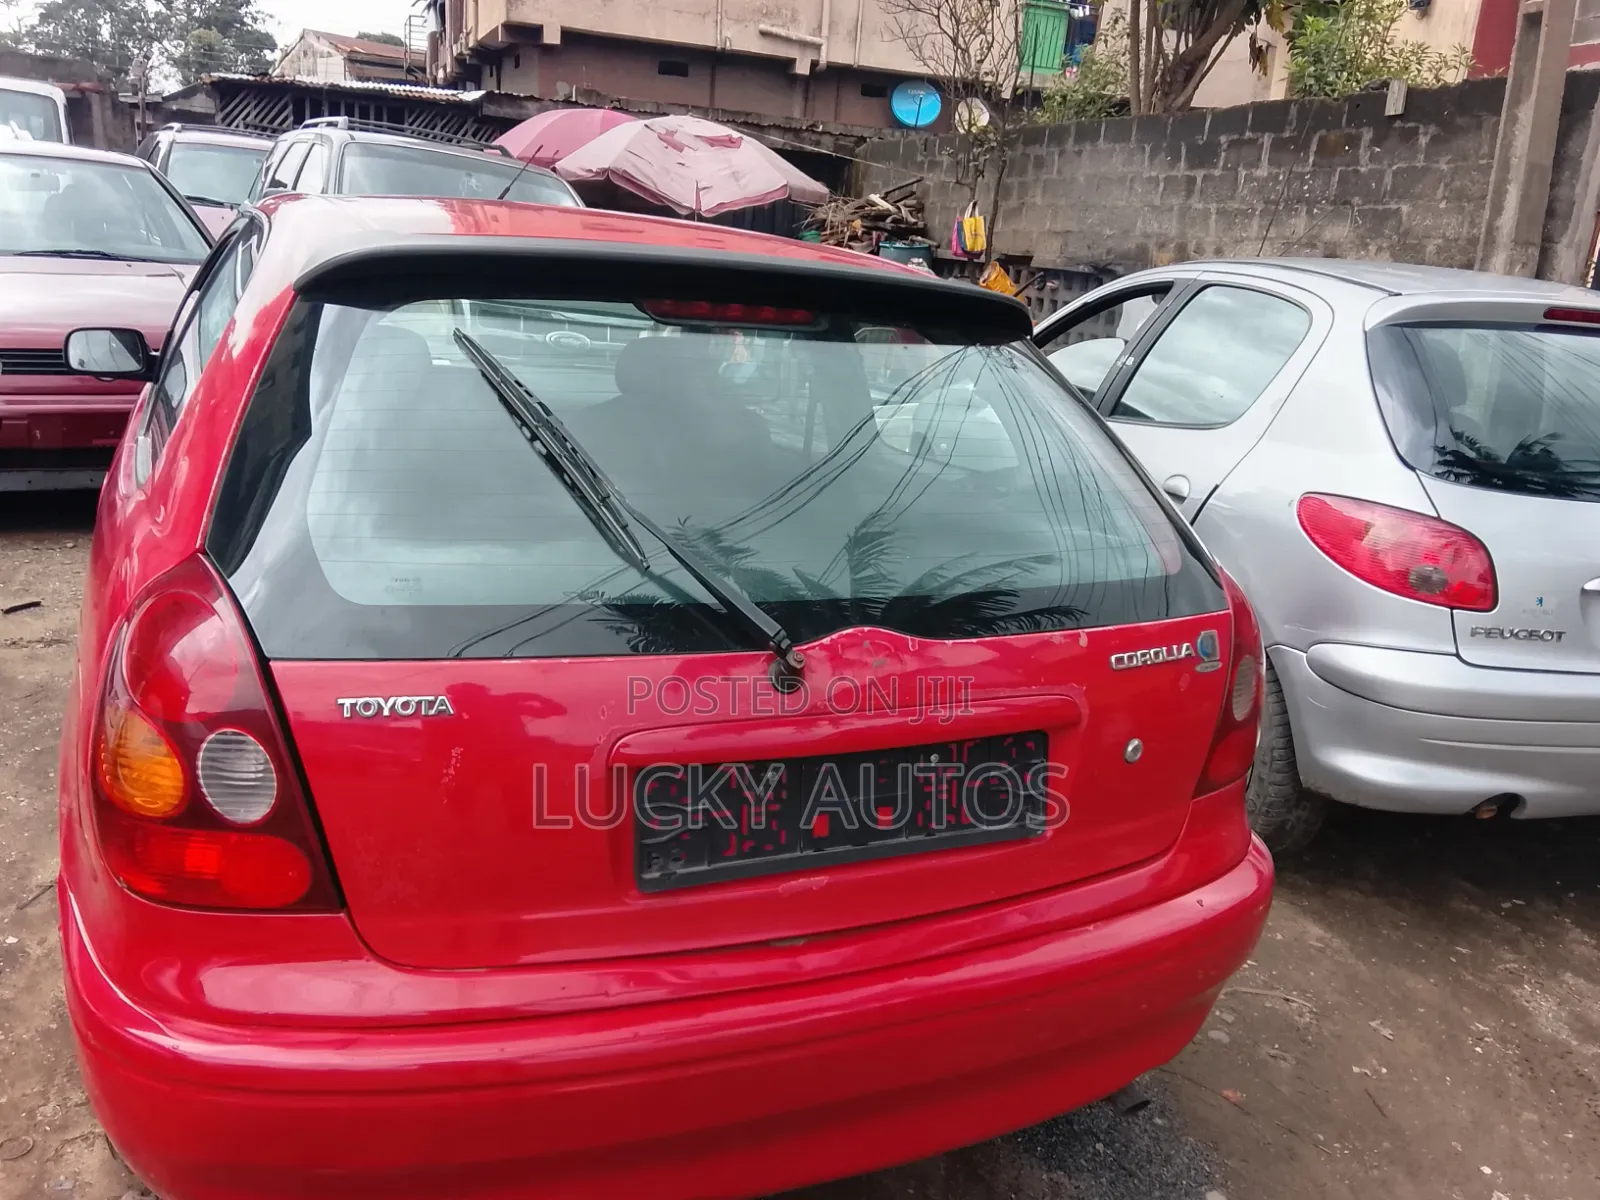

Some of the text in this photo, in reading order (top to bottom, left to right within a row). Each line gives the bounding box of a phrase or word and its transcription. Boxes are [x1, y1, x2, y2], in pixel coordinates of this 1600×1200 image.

[1470, 625, 1566, 642] PEUGEOT
[1110, 642, 1195, 670] COROLLA
[337, 695, 454, 718] TOYOTA
